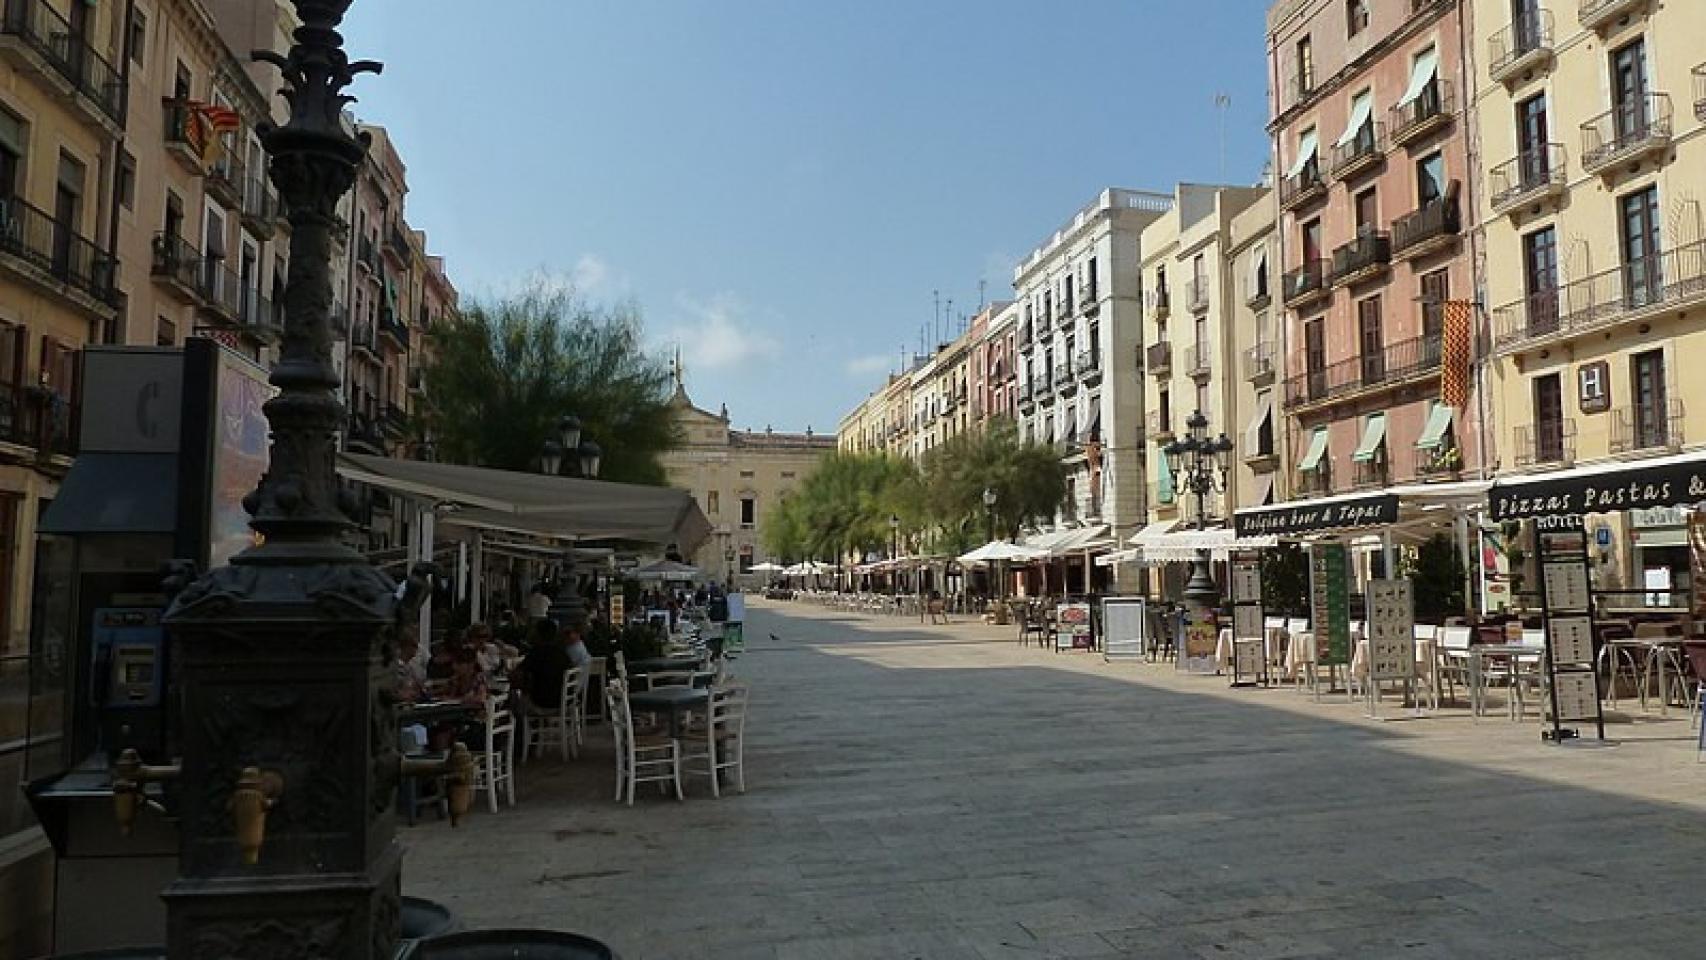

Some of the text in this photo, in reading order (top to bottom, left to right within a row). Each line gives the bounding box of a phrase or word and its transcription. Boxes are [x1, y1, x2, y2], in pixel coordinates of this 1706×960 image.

[1581, 367, 1603, 399] H
[1498, 474, 1706, 515] Pizzas Pastas &
[1338, 505, 1383, 527] Tapas
